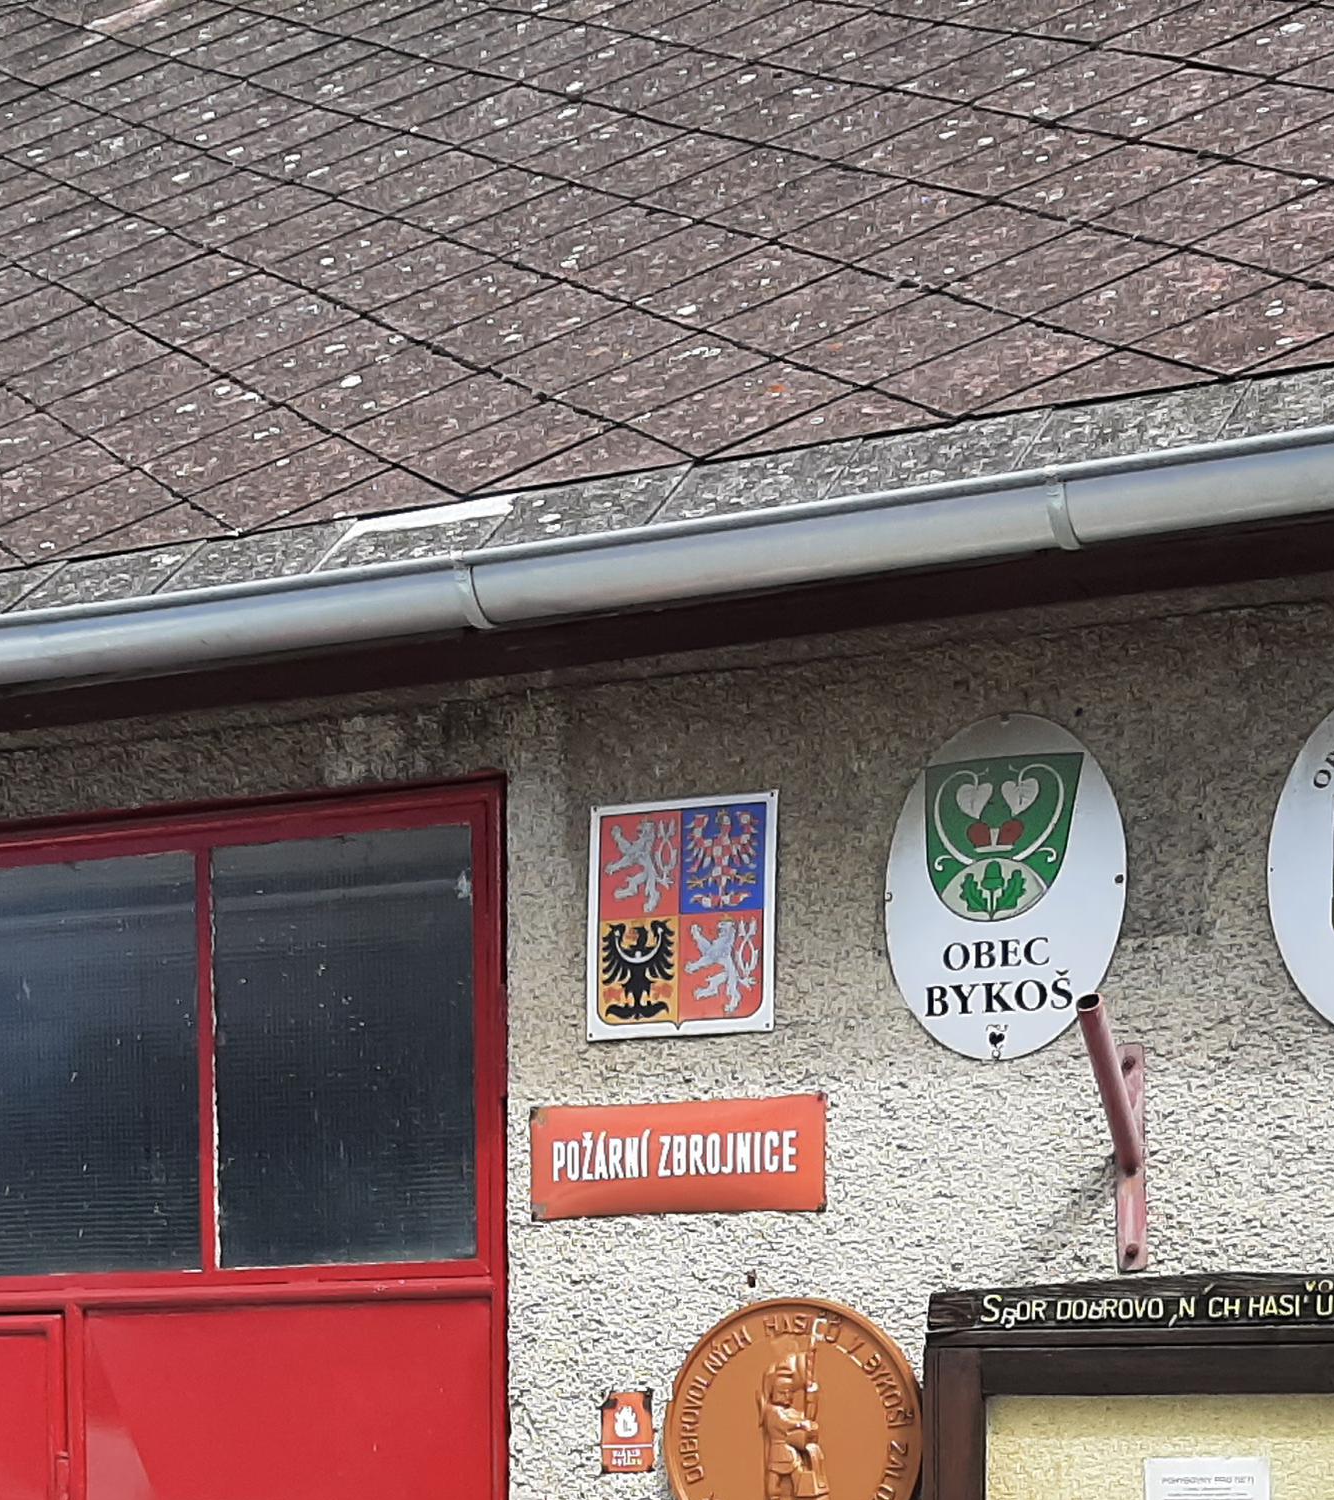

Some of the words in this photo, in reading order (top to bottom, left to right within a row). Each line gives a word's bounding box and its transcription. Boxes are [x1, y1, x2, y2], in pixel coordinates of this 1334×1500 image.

[942, 936, 1050, 972] OBEC
[925, 969, 1073, 1017] BYKOŠ
[552, 1128, 652, 1182] POŽÁRNÍ
[657, 1129, 798, 1178] ZBROJNICE
[980, 1293, 1047, 1329] SBOR
